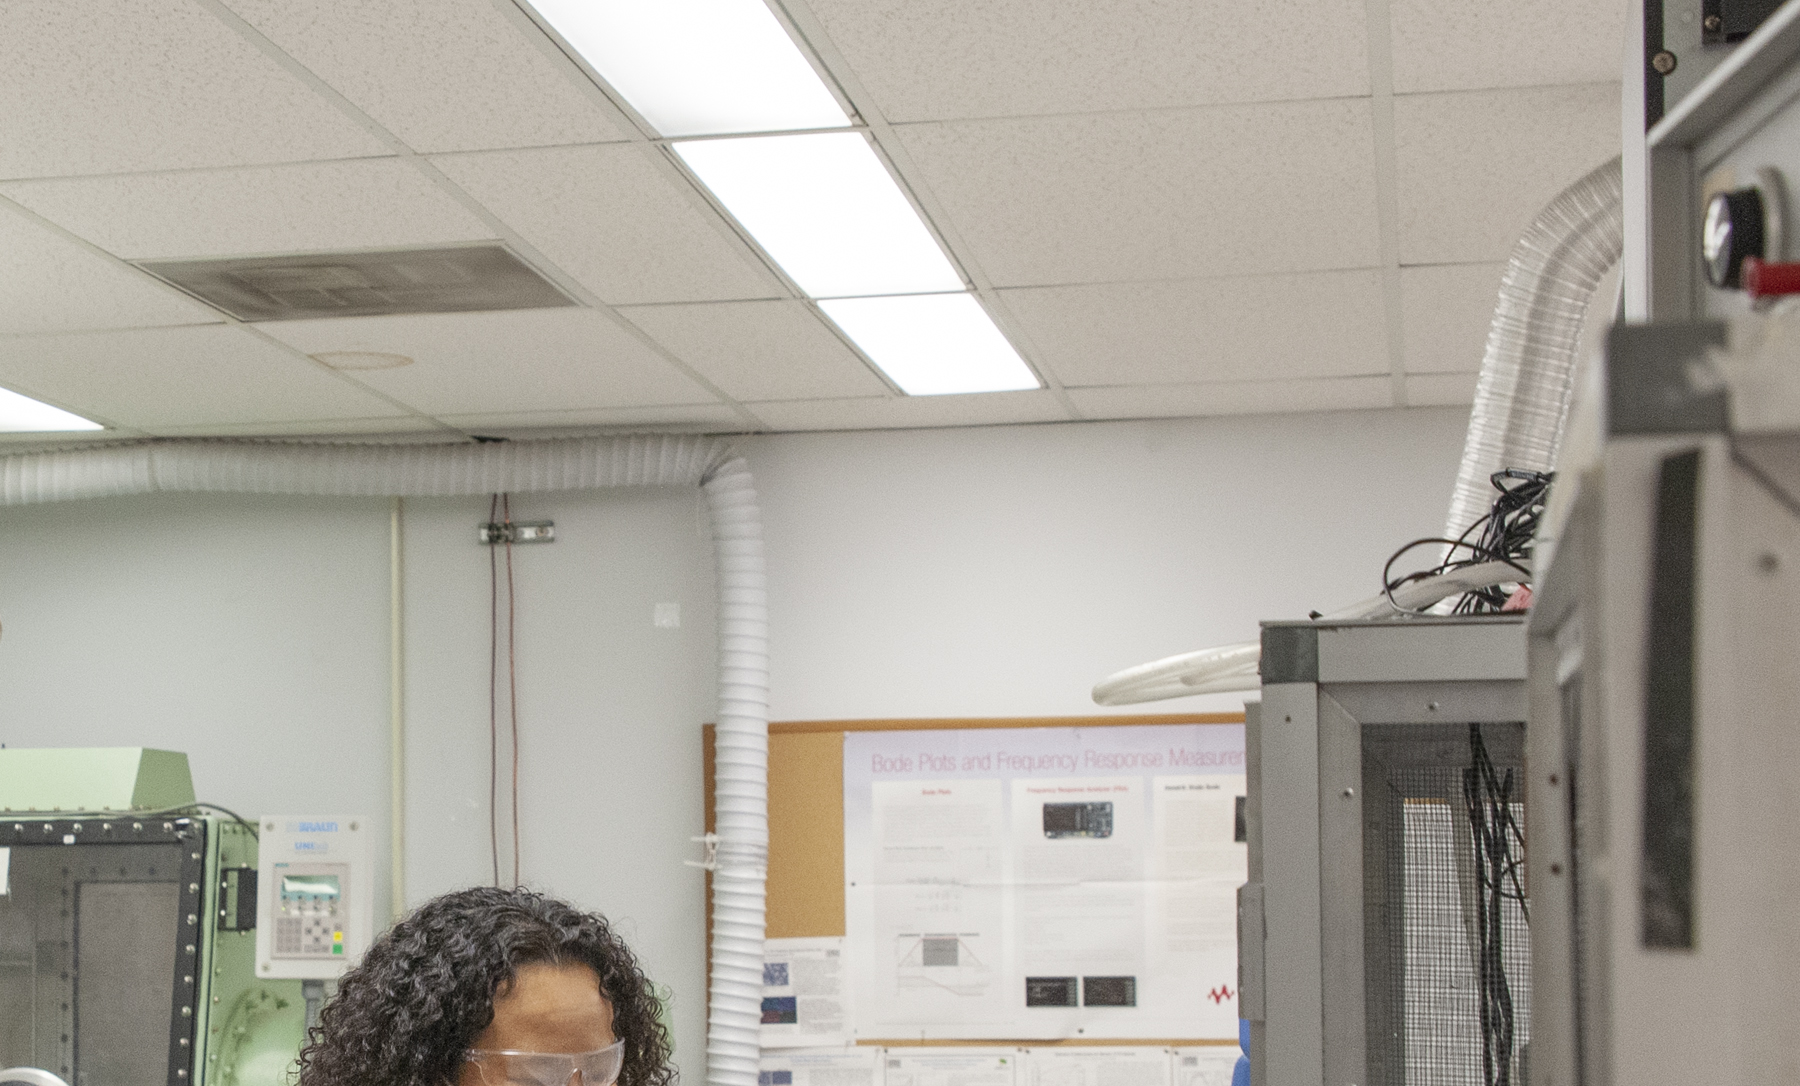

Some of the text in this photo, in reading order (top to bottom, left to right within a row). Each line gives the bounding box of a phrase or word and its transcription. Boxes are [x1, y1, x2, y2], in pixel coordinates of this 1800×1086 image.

[871, 753, 913, 773] Bode
[918, 752, 956, 772] Plots
[961, 752, 992, 771] and
[996, 751, 1078, 772] Frequency
[1084, 749, 1163, 769] Response
